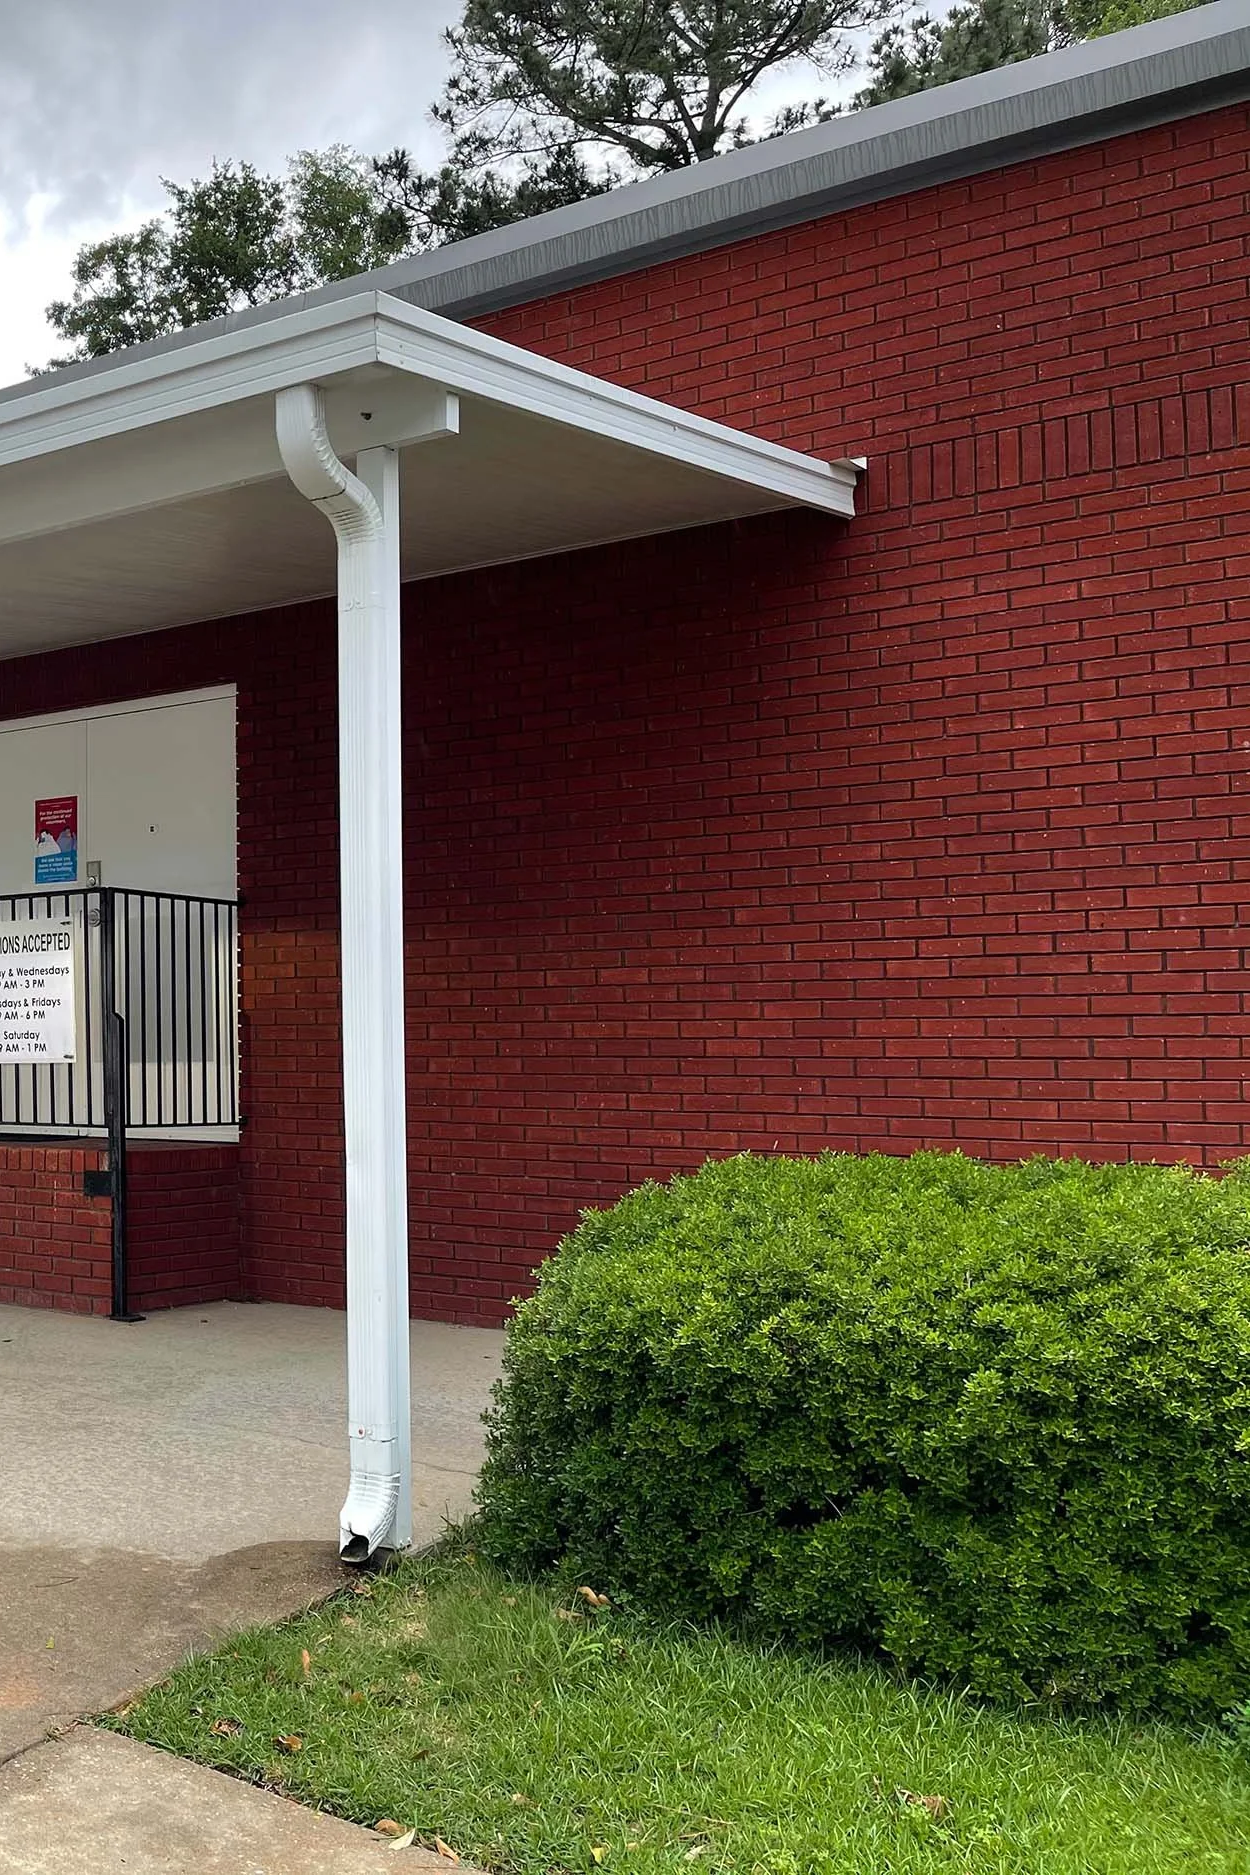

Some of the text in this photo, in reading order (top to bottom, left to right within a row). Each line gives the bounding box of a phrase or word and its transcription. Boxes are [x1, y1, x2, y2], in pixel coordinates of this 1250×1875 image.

[22, 932, 70, 952] ACCEPTED
[9, 969, 13, 977] &
[16, 966, 69, 977] Wednesdays
[4, 980, 17, 989] AM
[25, 980, 30, 988] 3
[32, 979, 45, 988] PM
[32, 998, 61, 1007] Fridays
[4, 1011, 18, 1020] AM
[26, 1011, 30, 1019] 6
[34, 1010, 45, 1019] PM
[4, 1031, 40, 1041] Saturday
[6, 1043, 19, 1052] AM
[34, 1043, 46, 1051] PM
